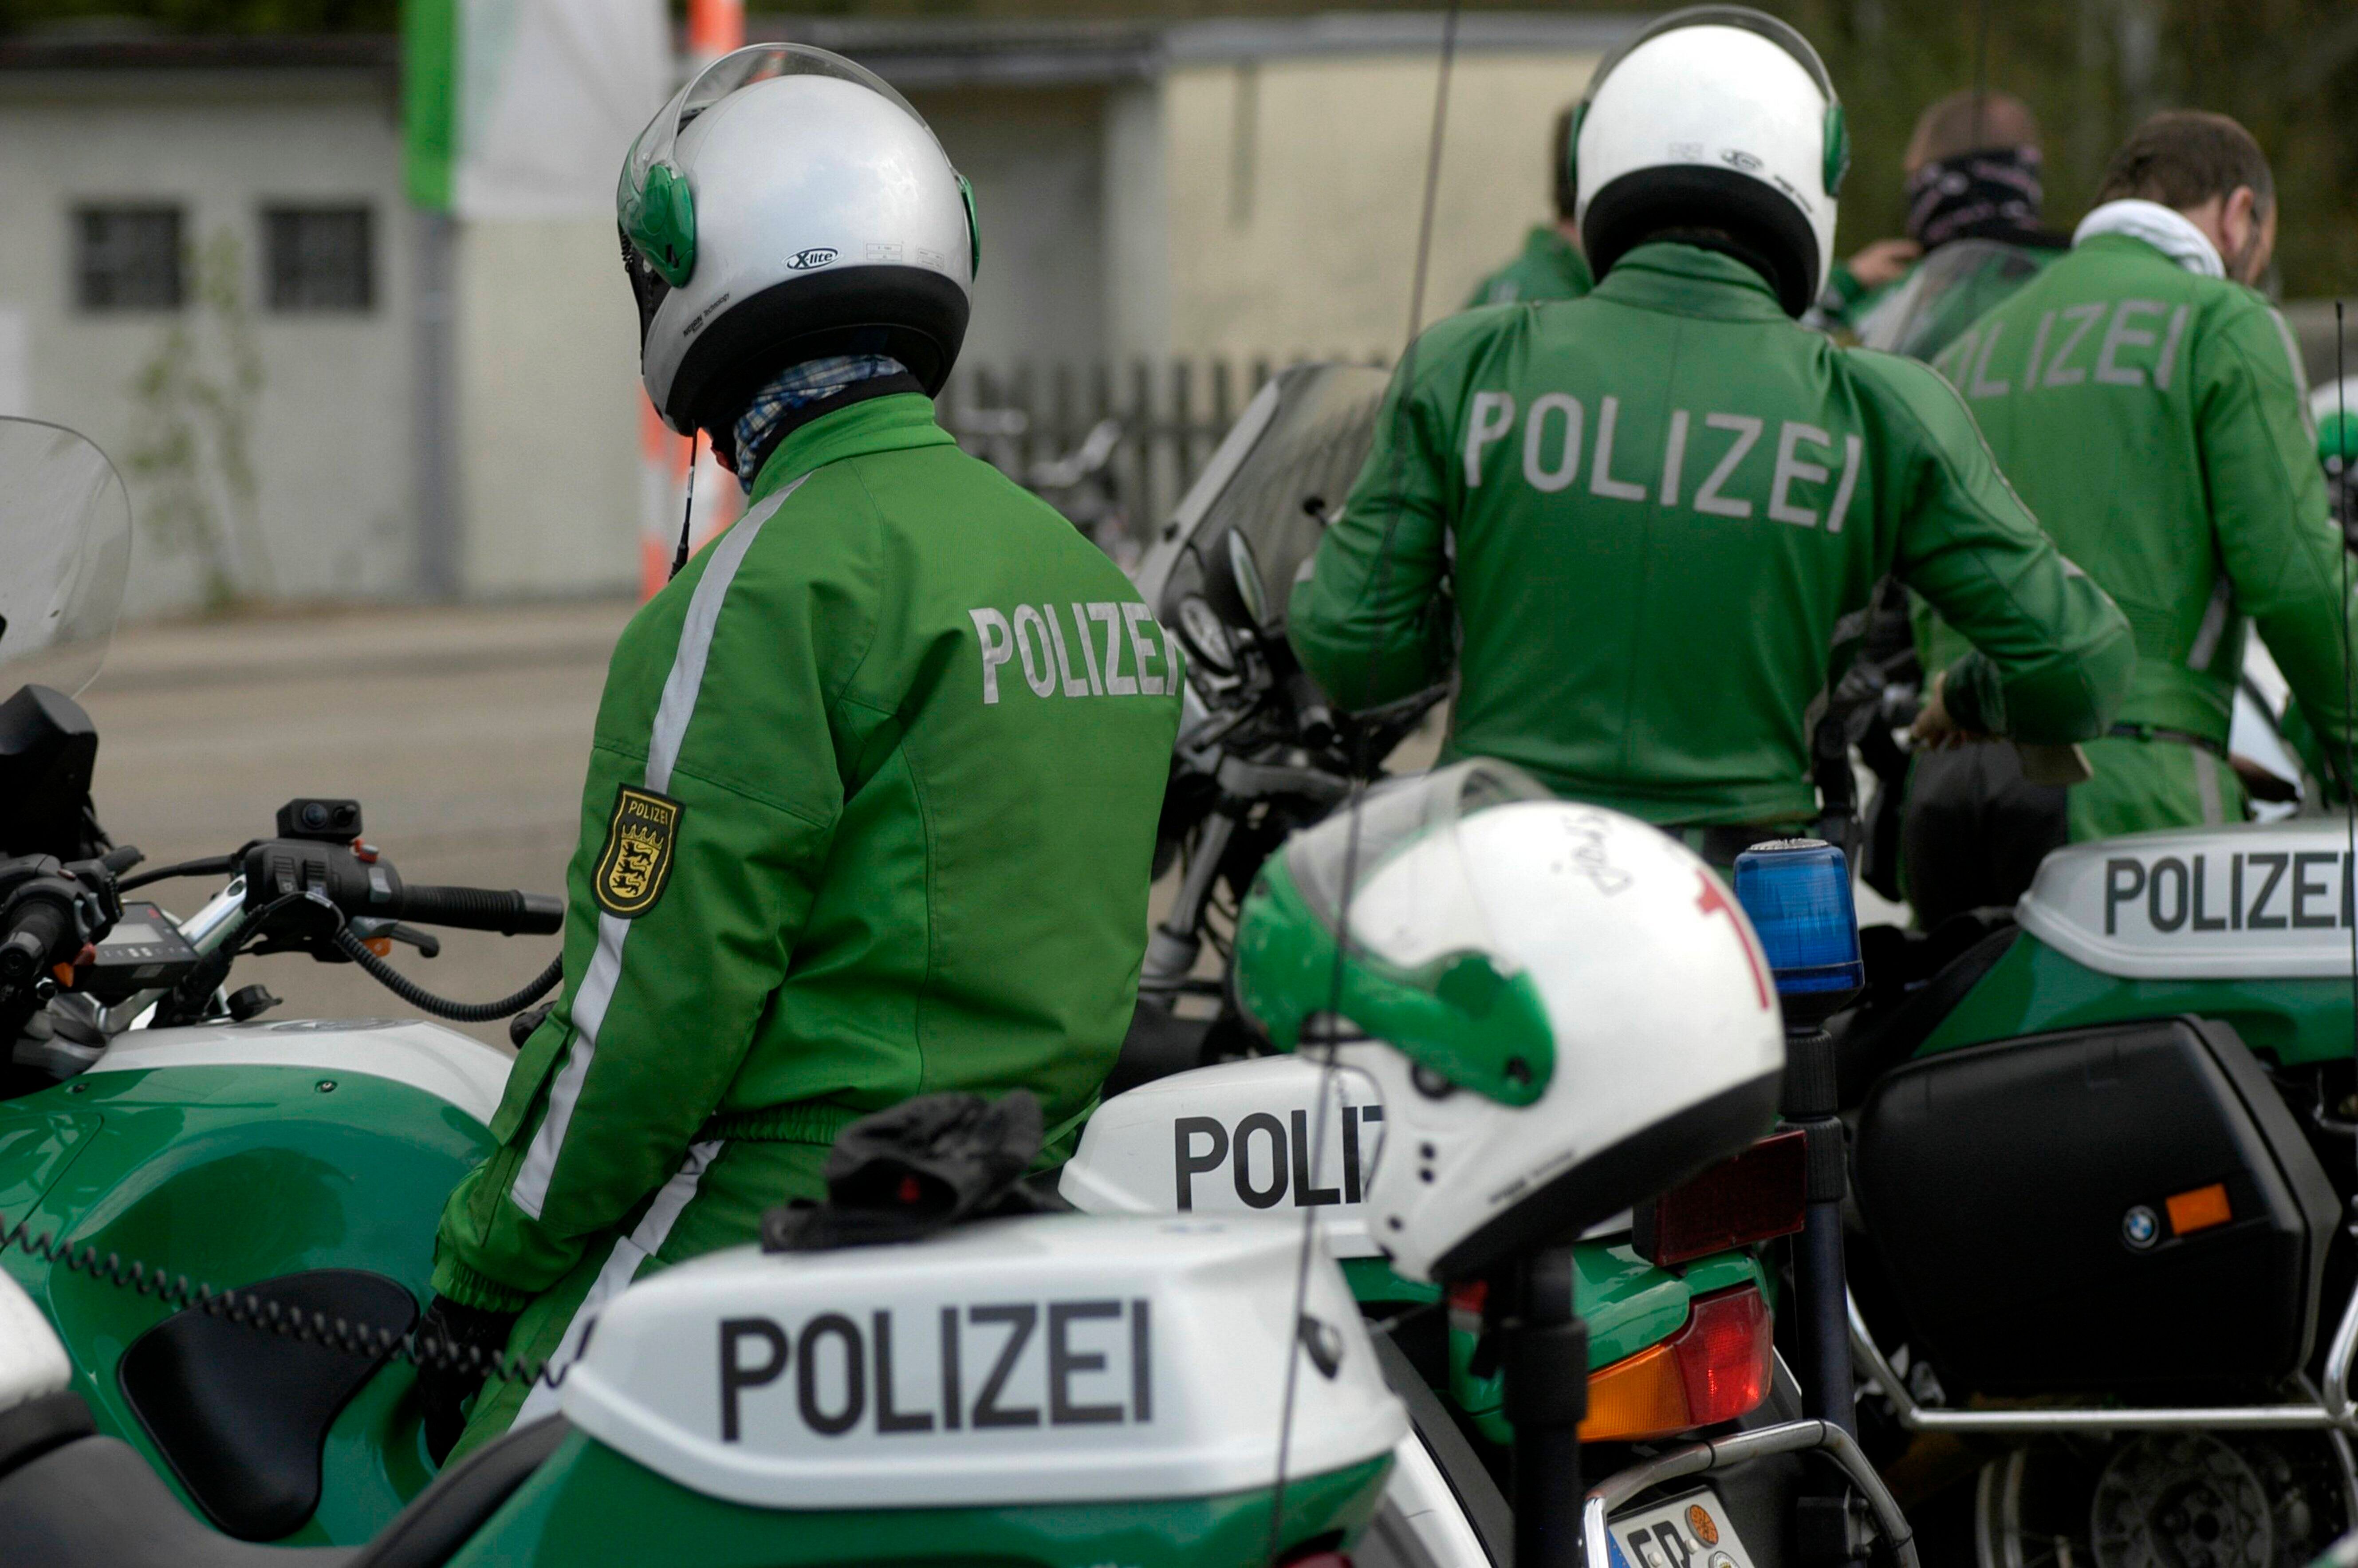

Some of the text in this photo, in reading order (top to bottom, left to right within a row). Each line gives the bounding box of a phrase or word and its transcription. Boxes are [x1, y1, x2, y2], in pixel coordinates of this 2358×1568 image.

[794, 251, 833, 268] X-lite
[1464, 391, 1862, 534] POLIZEI
[968, 602, 1178, 704] POLIZEI
[628, 800, 668, 826] POLIZEI
[2105, 851, 2354, 935] POLIZEI
[1175, 1105, 1383, 1213] POLI
[719, 1299, 1153, 1444] POLIZEI
